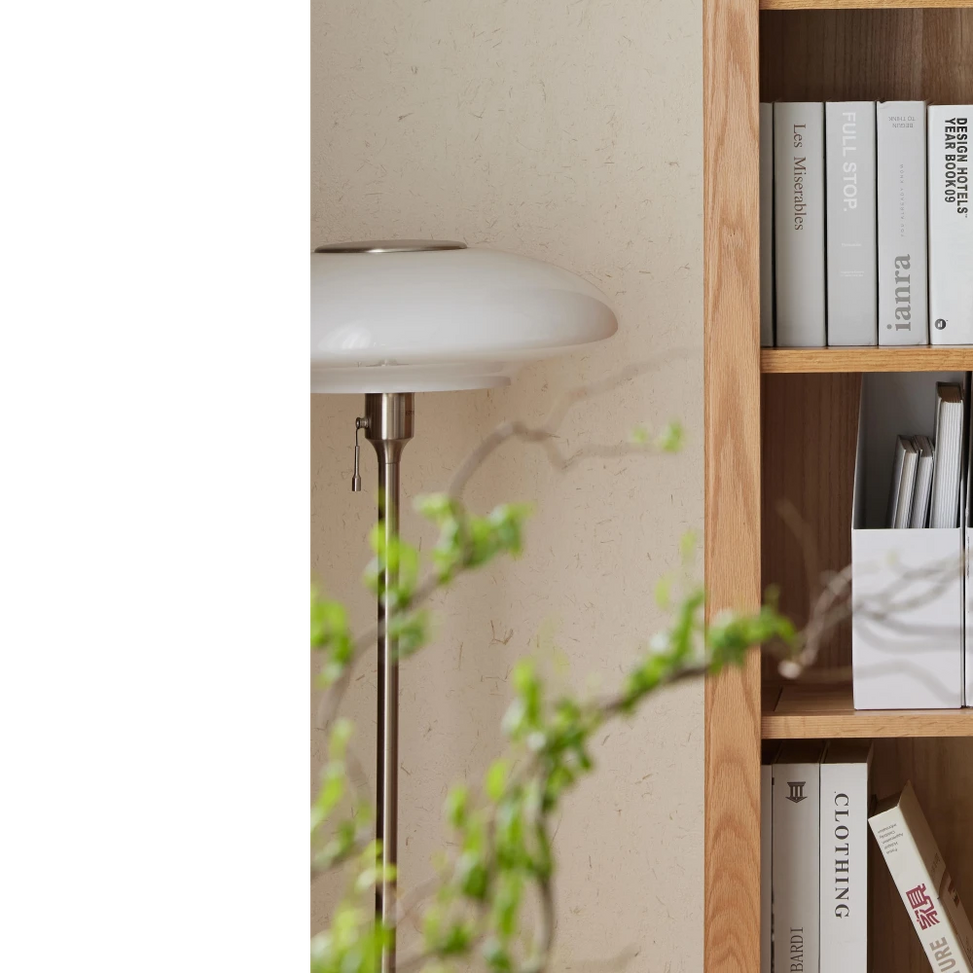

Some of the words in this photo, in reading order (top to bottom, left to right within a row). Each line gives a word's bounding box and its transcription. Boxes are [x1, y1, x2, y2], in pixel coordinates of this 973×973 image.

[793, 124, 807, 148] Les
[842, 112, 857, 157] FULL
[945, 117, 956, 149] YEAR
[957, 118, 968, 163] DESIGN
[794, 156, 807, 231] Miserables
[843, 162, 858, 212] STOP.
[886, 253, 911, 331] ianra
[834, 793, 850, 918] CLOTHING
[790, 927, 804, 973] BARDI
[929, 936, 960, 973] URE
